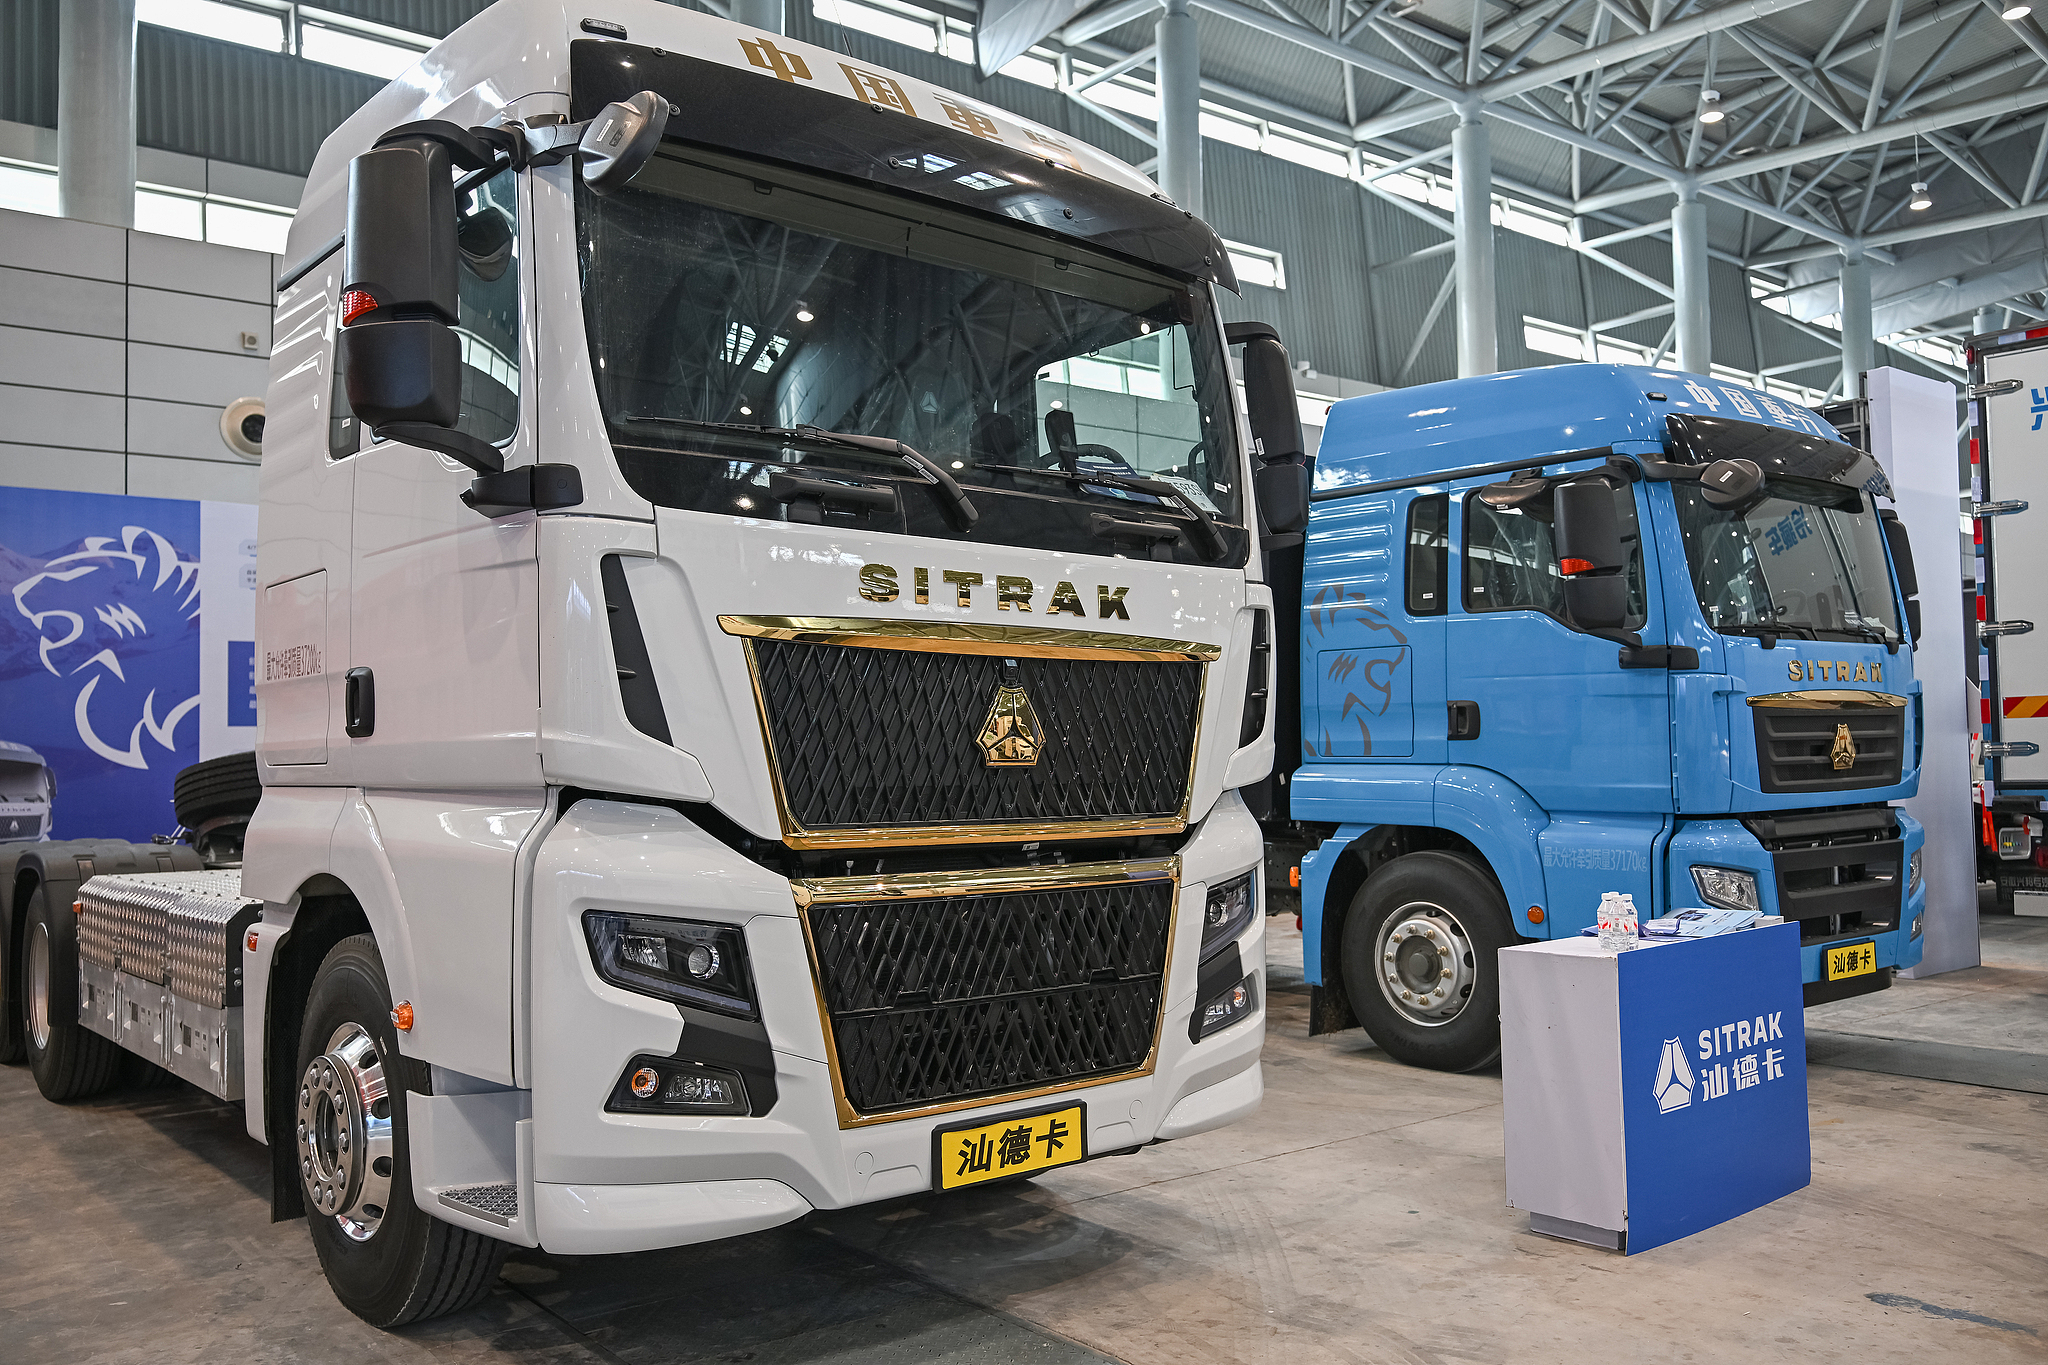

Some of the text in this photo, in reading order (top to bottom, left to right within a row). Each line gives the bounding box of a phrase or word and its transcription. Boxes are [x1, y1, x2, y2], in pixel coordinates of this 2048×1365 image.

[1683, 379, 1825, 437] 中国重汽
[859, 563, 1131, 621] SITRAK
[1788, 660, 1883, 683] SITRAK
[1832, 948, 1872, 975] 汕德卡
[1698, 1010, 1785, 1060] SITRAK
[1700, 1048, 1786, 1102] 汕德卡
[956, 1118, 1069, 1176] 汕德卡
